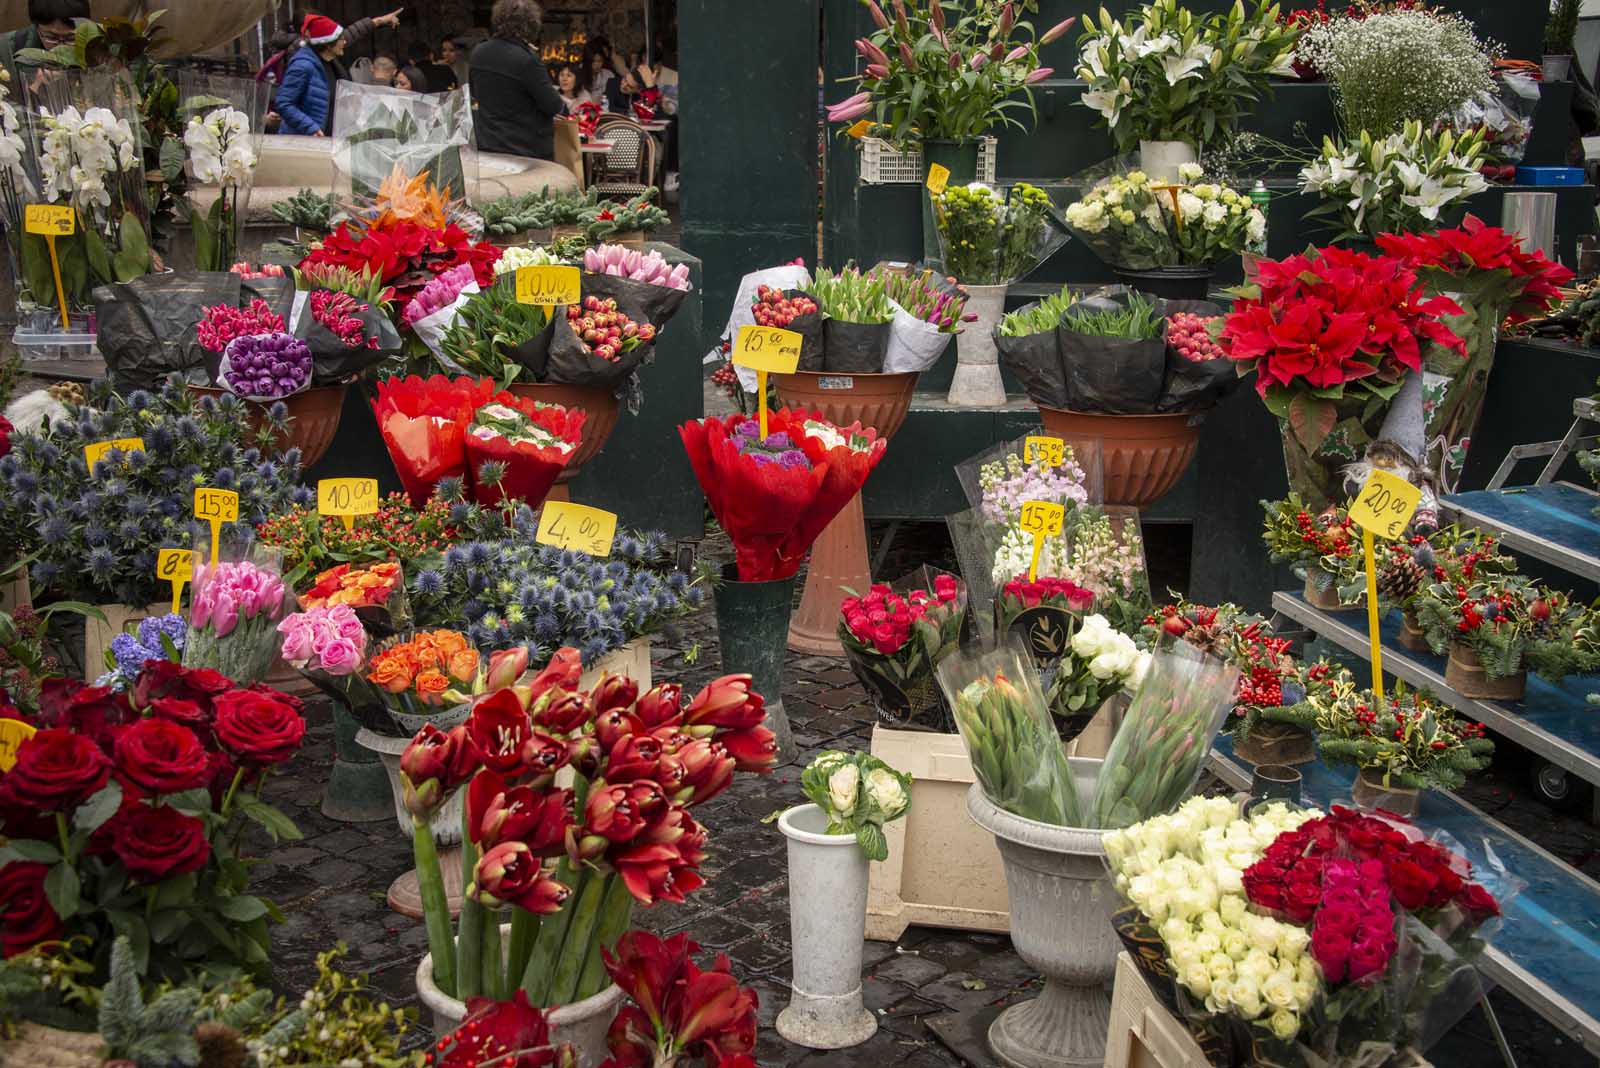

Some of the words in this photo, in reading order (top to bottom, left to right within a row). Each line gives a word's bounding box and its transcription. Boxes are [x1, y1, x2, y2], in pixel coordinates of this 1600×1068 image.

[1051, 454, 1059, 464] €
[224, 509, 233, 519] €
[1047, 521, 1058, 533] €
[1387, 520, 1402, 537] €
[590, 539, 607, 553] €
